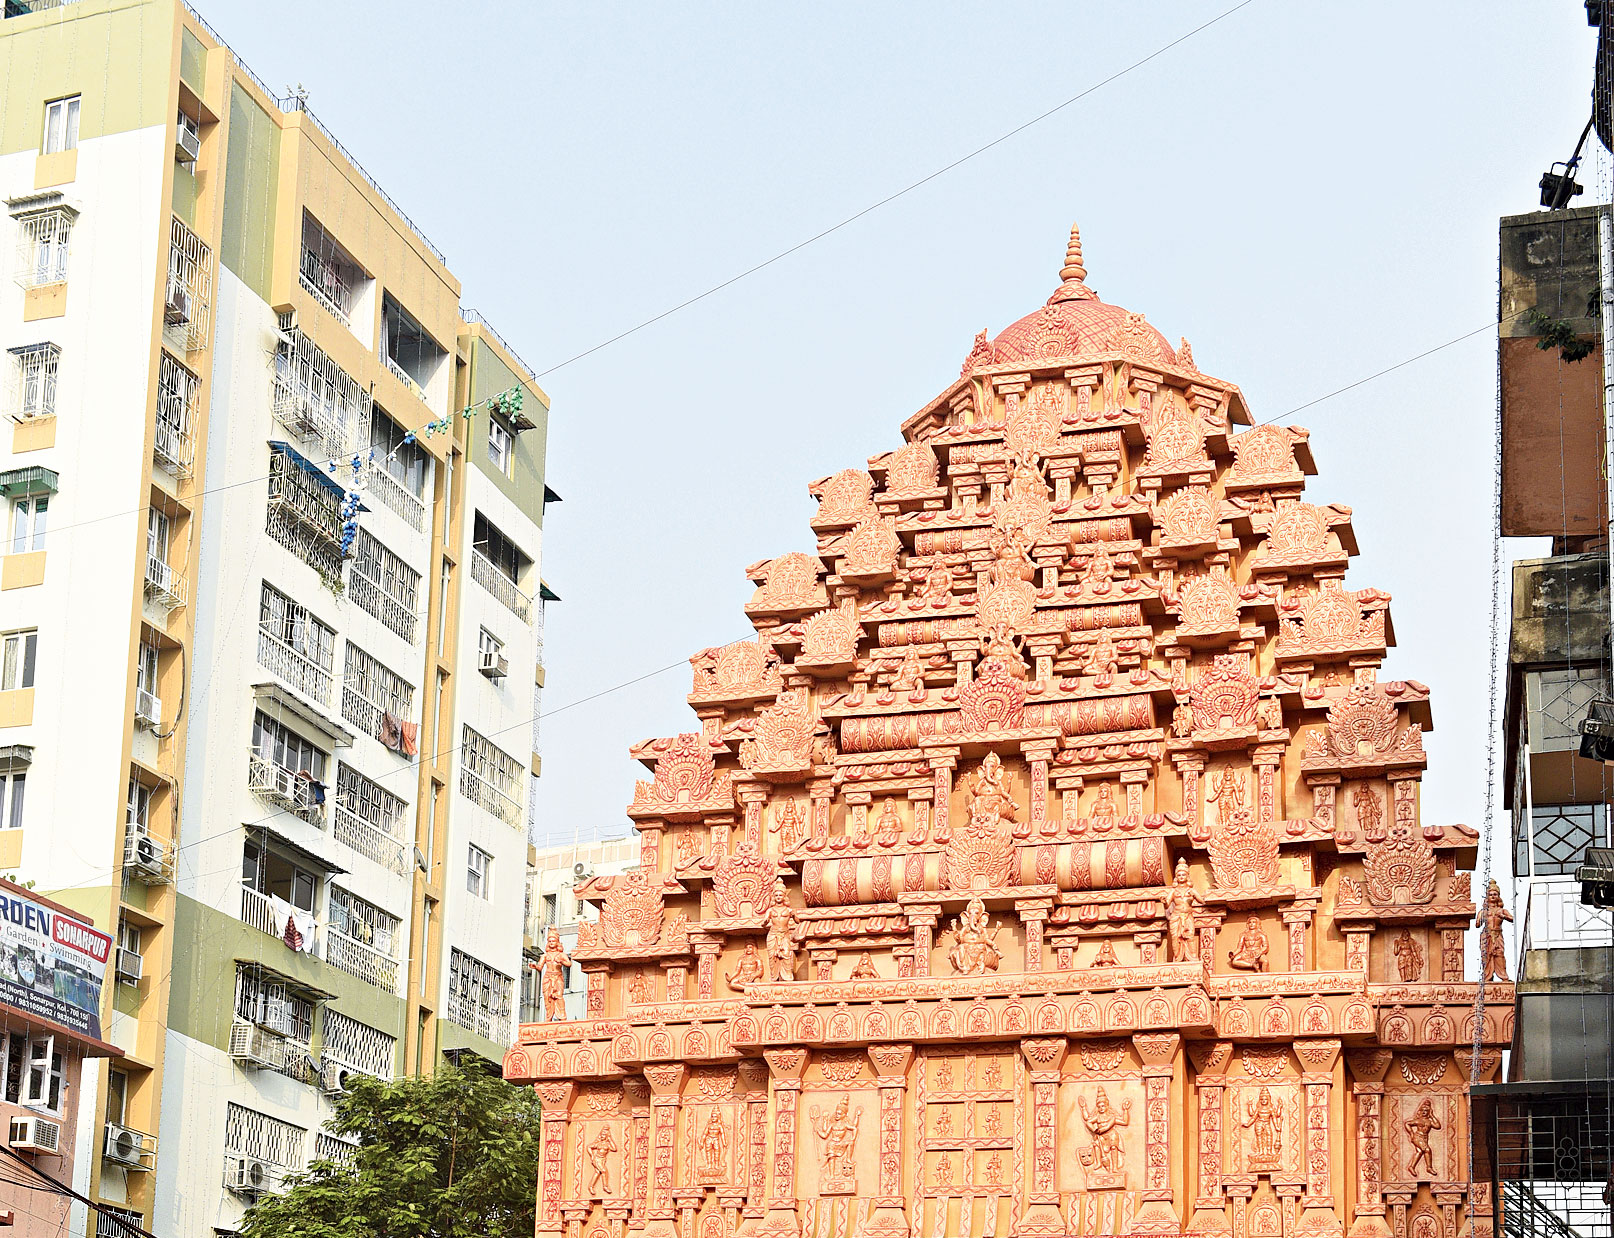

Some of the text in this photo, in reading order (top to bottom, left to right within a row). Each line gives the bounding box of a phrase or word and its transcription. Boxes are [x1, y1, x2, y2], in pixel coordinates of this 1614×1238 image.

[7, 926, 92, 970] Garden Swimming
[56, 920, 107, 958] SONARPUR
[29, 992, 55, 1010] Sonarpur,
